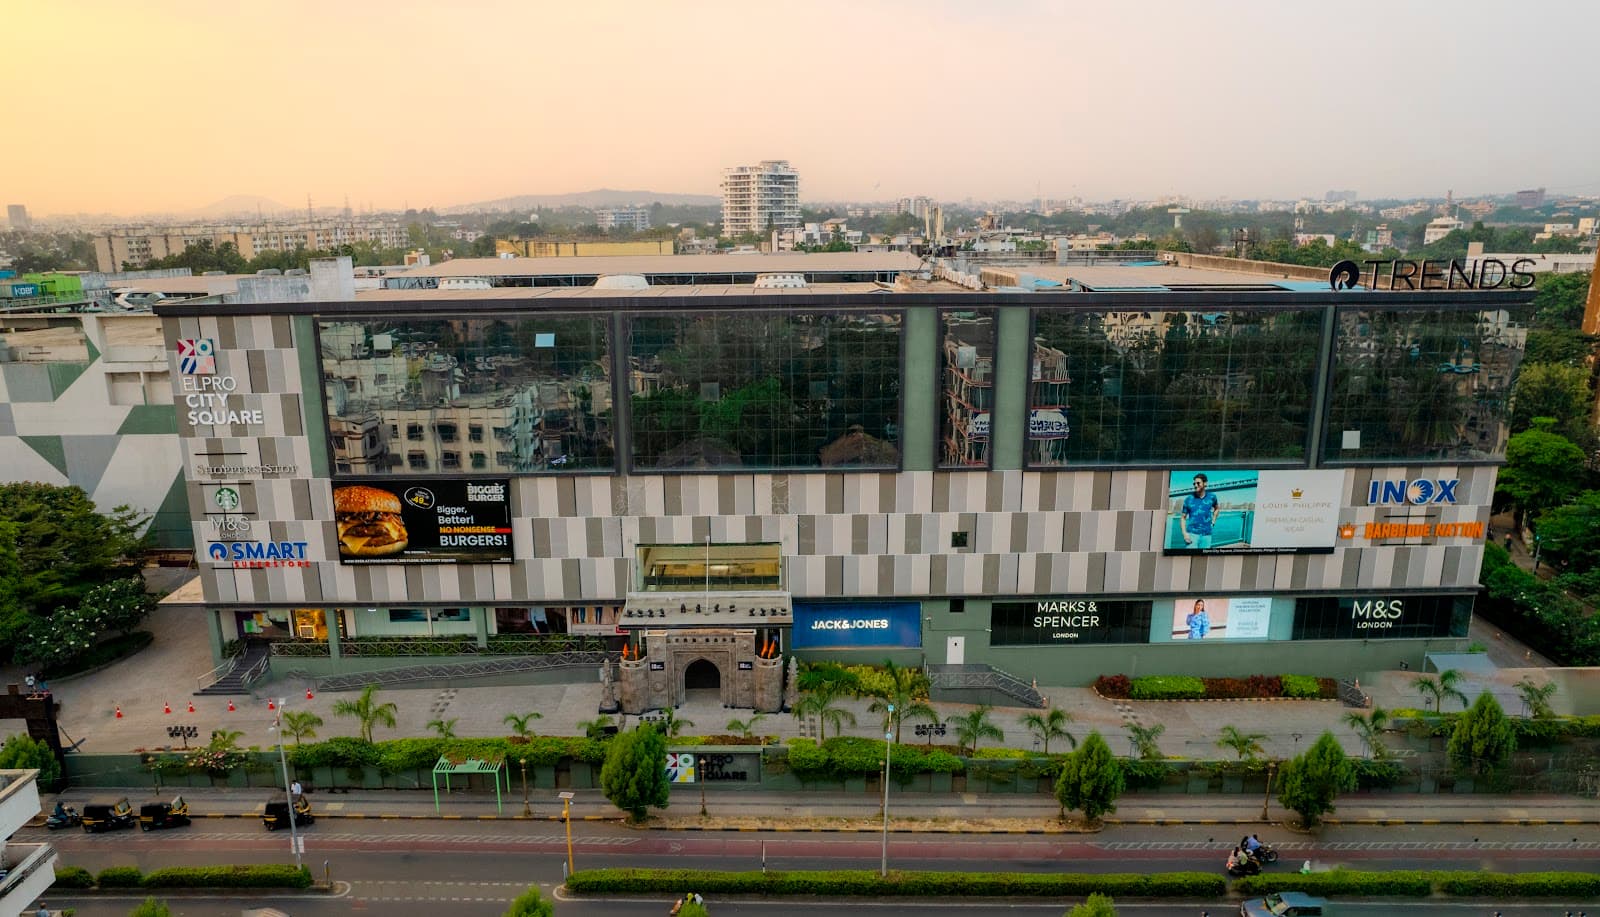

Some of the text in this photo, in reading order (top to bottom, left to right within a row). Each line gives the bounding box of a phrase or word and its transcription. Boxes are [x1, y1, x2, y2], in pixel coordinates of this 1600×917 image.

[1363, 258, 1537, 290] TRENDS
[183, 375, 237, 392] ELPRO
[186, 393, 228, 408] CITY
[188, 409, 264, 426] SQUARE
[467, 494, 505, 502] BURGER
[1368, 478, 1460, 505] INOX
[436, 505, 468, 515] Bigger,
[210, 516, 250, 531] M&S
[438, 515, 474, 525] Better!
[439, 526, 452, 534] NO
[1364, 521, 1485, 540] BARBEQUE NATION
[439, 535, 508, 546] BURGERS!
[231, 541, 308, 560] SMART
[234, 560, 311, 568] SUPERSTORE
[1037, 601, 1097, 613] MARKS &
[1351, 600, 1403, 619] M&S
[811, 619, 889, 630] JACK&JONES
[1033, 615, 1100, 628] SPENCER
[1356, 621, 1393, 629] LONDON
